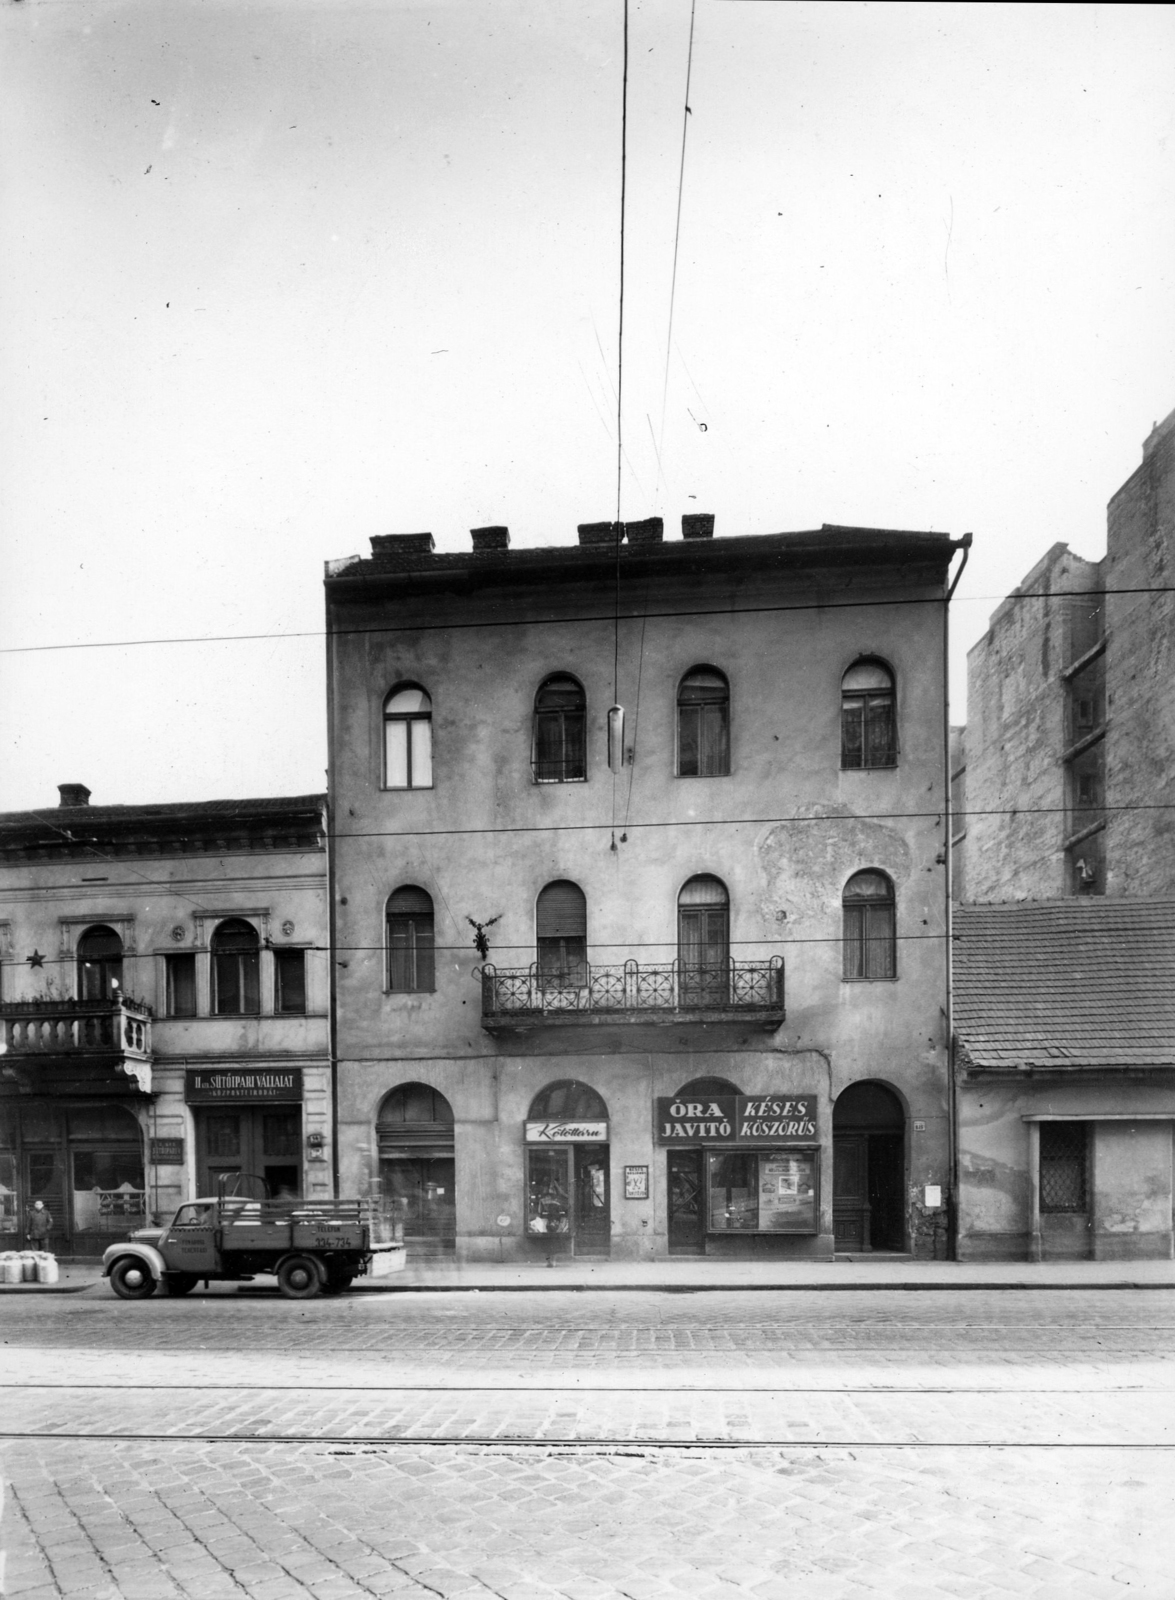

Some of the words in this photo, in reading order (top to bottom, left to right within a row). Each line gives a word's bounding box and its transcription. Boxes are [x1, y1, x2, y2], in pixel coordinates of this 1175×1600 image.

[256, 1072, 294, 1088] VÁLLALAT
[743, 1096, 808, 1117] KÉSES
[739, 1117, 817, 1137] KÖSZÖRŰS
[315, 1237, 351, 1248] 334-734
